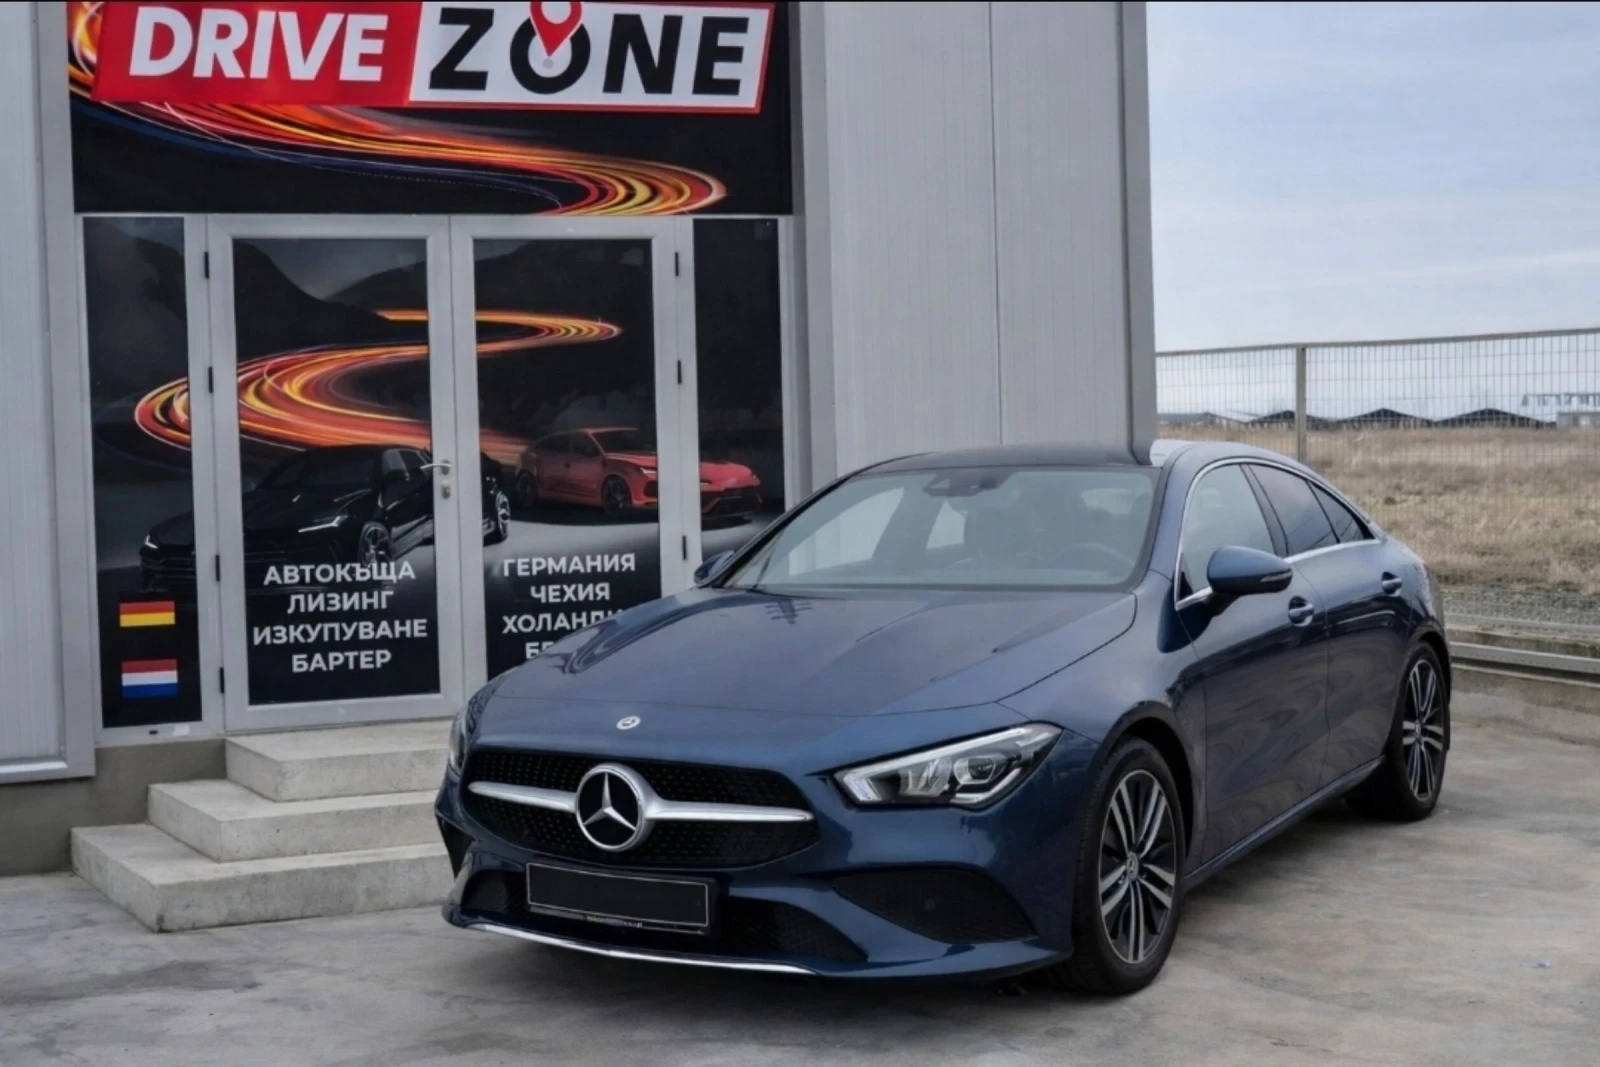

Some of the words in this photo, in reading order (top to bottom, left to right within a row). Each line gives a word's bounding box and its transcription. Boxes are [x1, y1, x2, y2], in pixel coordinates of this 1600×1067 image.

[129, 6, 388, 82] DRIVE
[428, 7, 749, 95] ZONE
[263, 560, 416, 586] АВТОКЪЩА
[503, 553, 636, 577] ГЕРМАНИЯ
[287, 590, 395, 615] ЛИЗИНГ
[530, 582, 611, 603] ЧЕХИЯ
[253, 618, 428, 646] ИЗКУПУВАНЕ
[502, 609, 622, 634] ХОЛАНД
[292, 649, 392, 673] БАРТЕР
